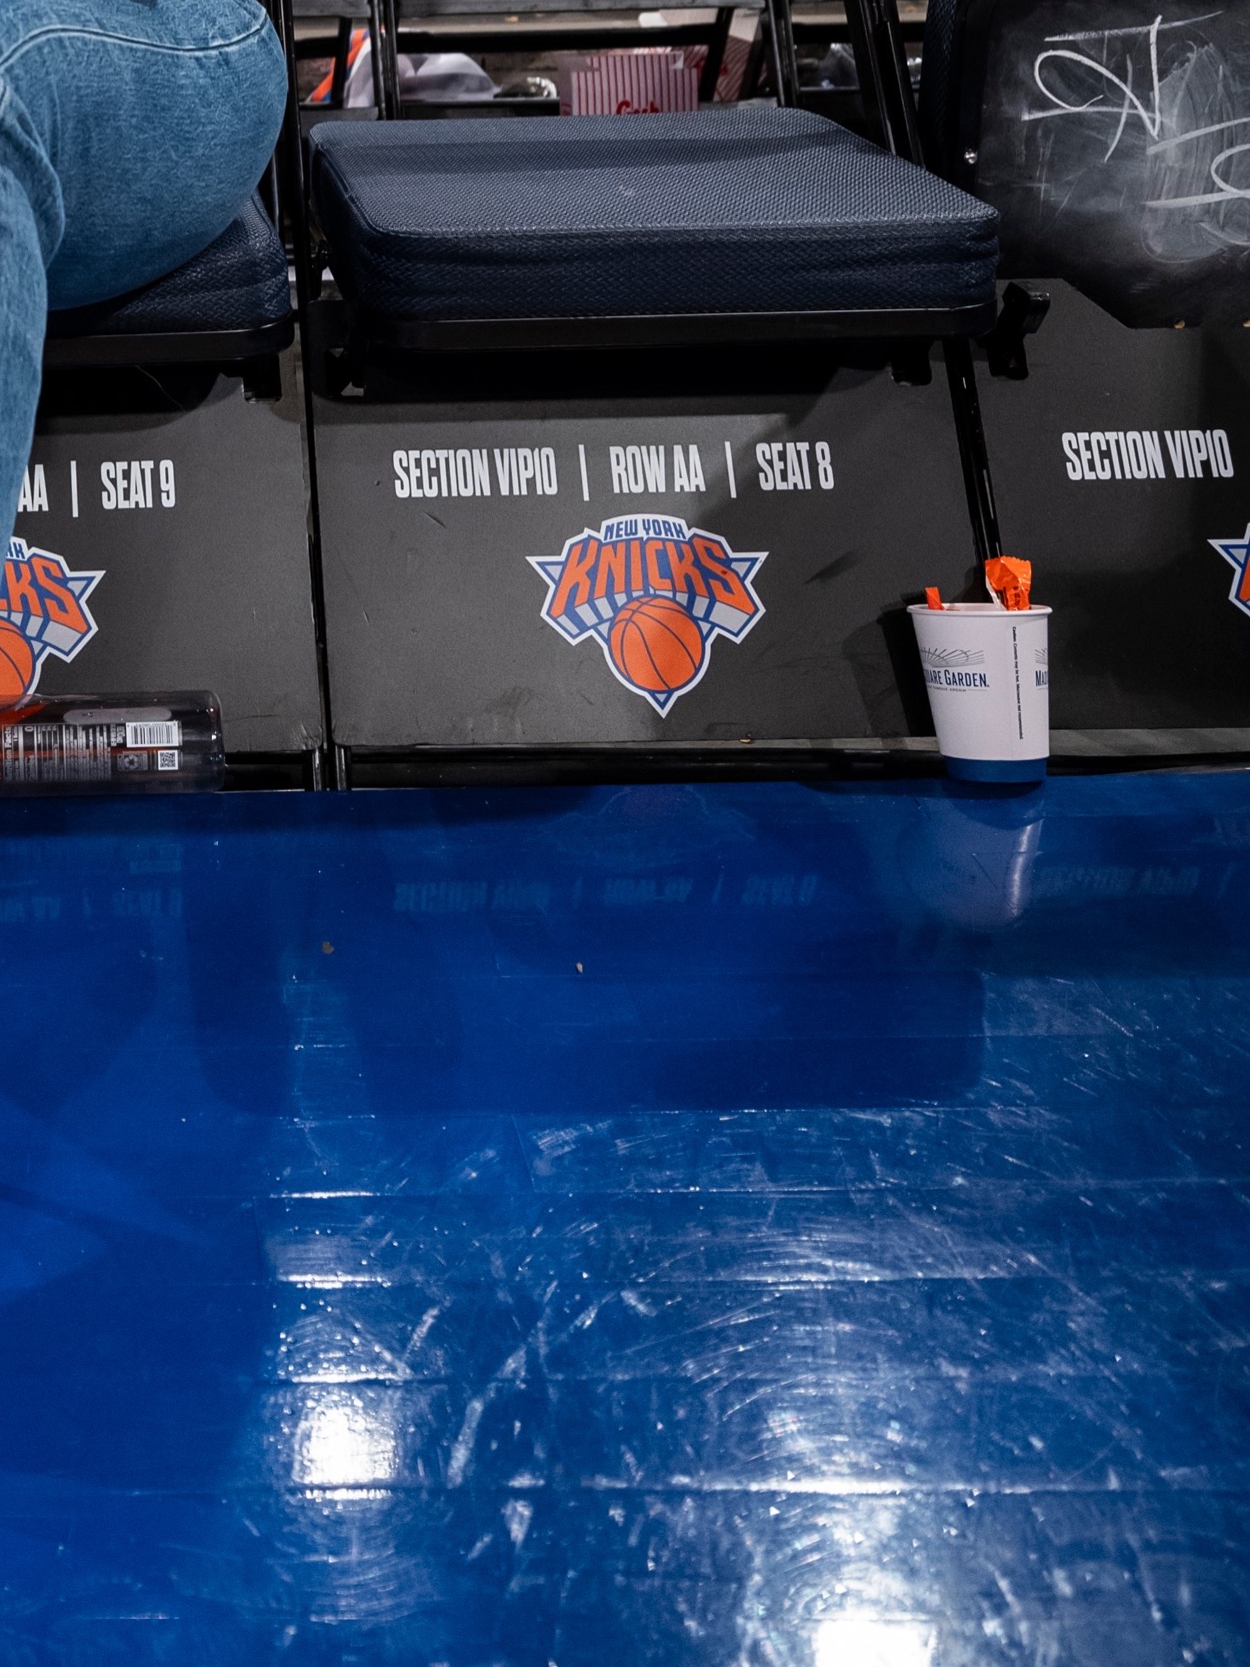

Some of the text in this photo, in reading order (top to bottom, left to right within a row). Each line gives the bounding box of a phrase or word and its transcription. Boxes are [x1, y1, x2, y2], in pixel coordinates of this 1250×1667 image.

[393, 441, 835, 498] SECTION VIP10 ROW AA SEAT 8
[1061, 429, 1235, 481] SECTION VIP10
[100, 460, 154, 510] SEAT
[159, 459, 176, 508] 9
[603, 518, 687, 542] NEW YORK
[550, 536, 756, 620] KNICKS
